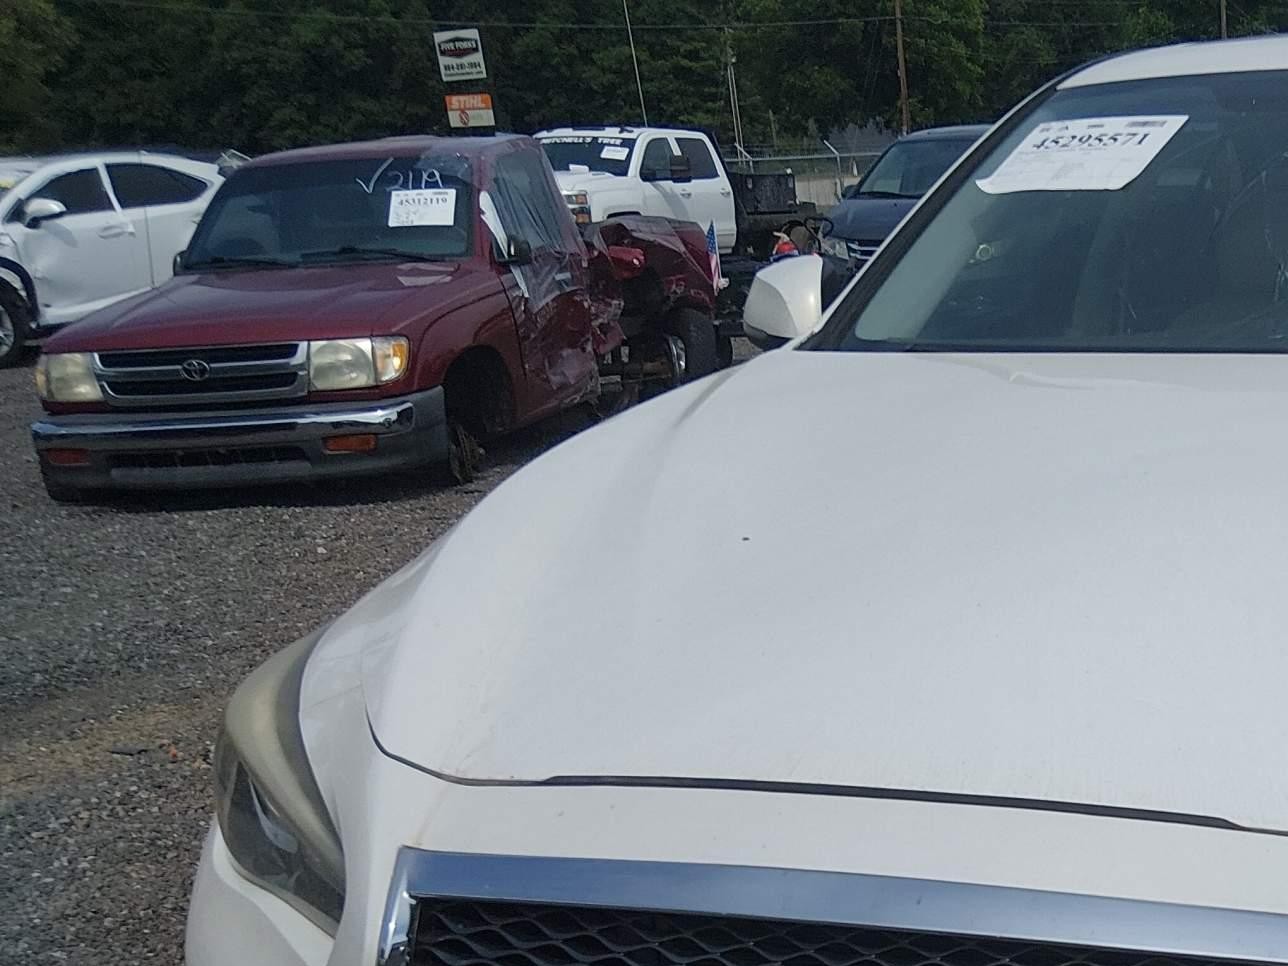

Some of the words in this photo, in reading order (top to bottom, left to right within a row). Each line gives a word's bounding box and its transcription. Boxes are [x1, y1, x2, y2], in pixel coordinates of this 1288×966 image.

[451, 95, 486, 109] STIHL
[598, 137, 624, 145] TREE
[1032, 132, 1151, 150] 45295571
[397, 197, 448, 206] 45312119
